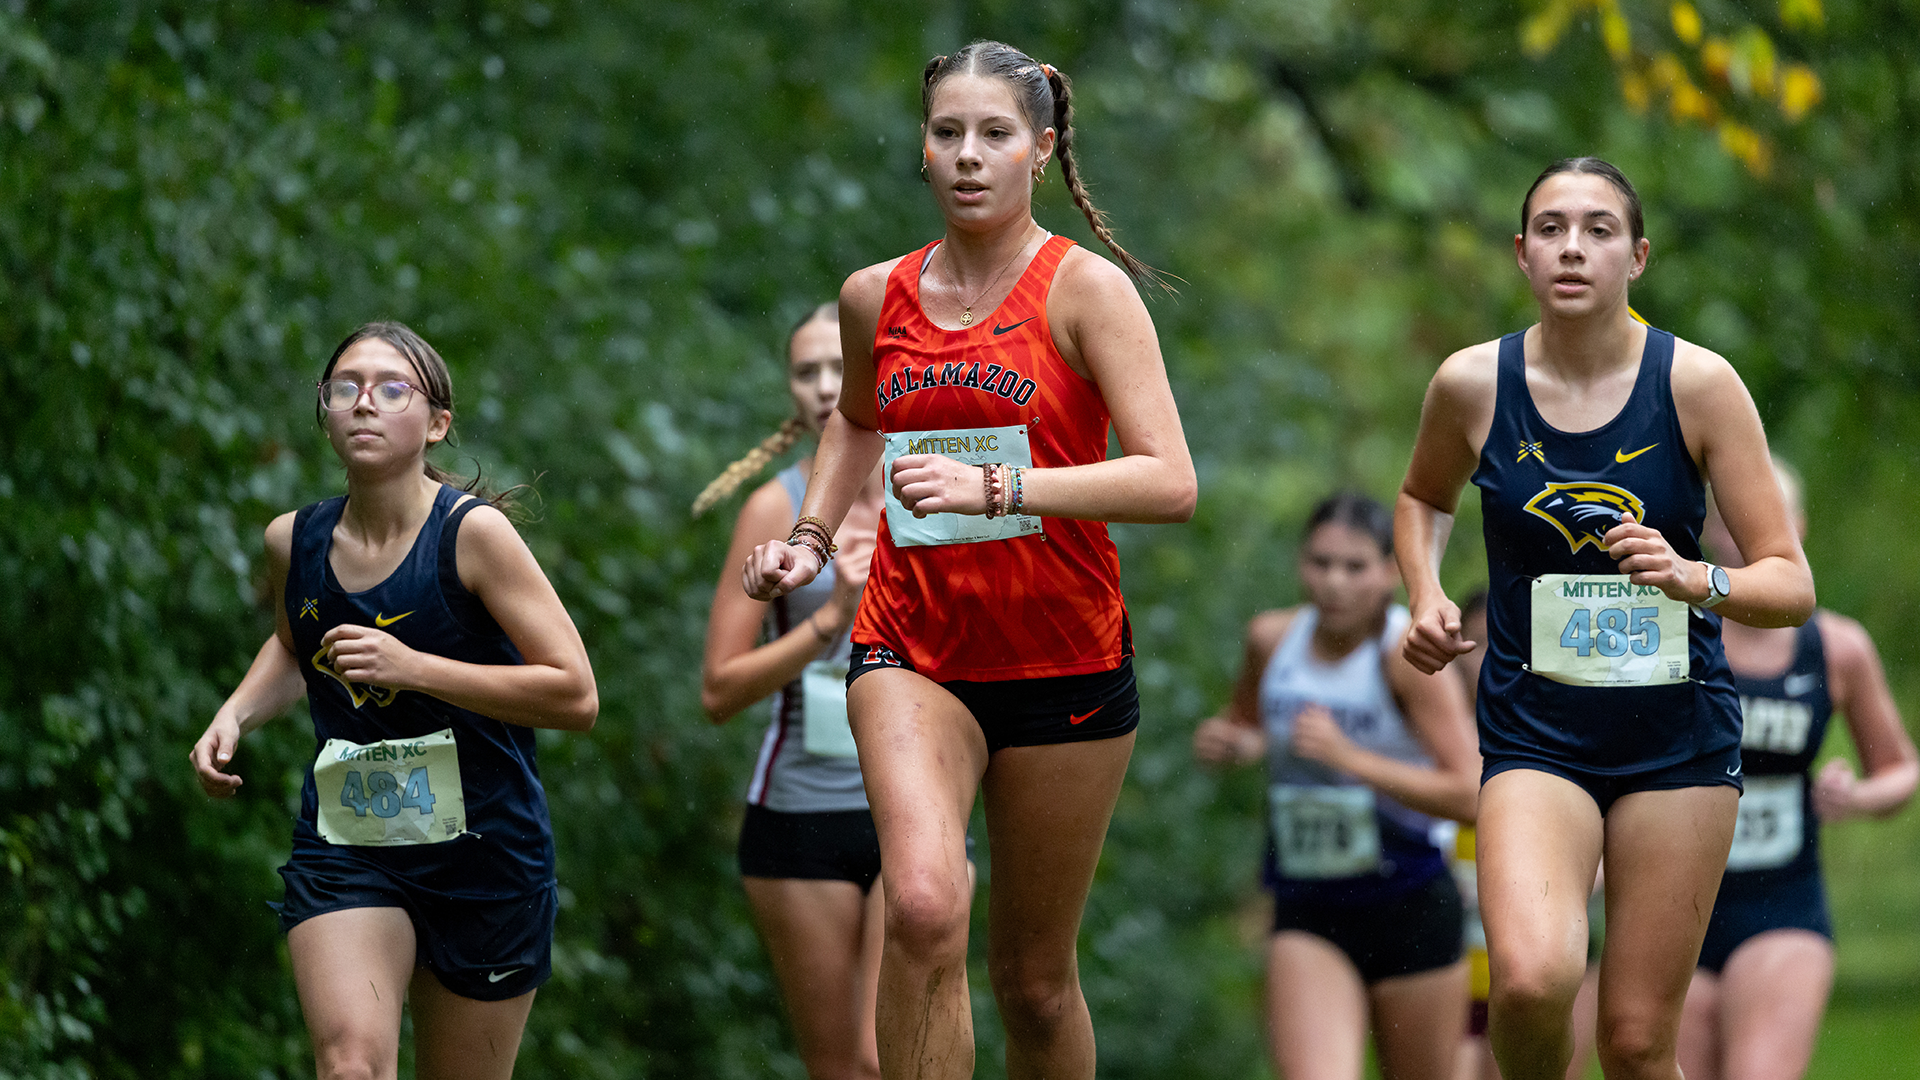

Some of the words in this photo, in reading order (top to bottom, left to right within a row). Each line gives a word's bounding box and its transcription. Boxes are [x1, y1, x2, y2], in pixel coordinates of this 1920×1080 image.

[877, 361, 1037, 412] KALAMAZOO
[908, 436, 971, 455] MITTEN
[974, 434, 999, 452] XC
[1563, 581, 1632, 598] MITTEN
[1636, 584, 1661, 596] XC
[1559, 606, 1661, 657] 485
[400, 740, 427, 759] XC
[340, 765, 436, 818] 484
